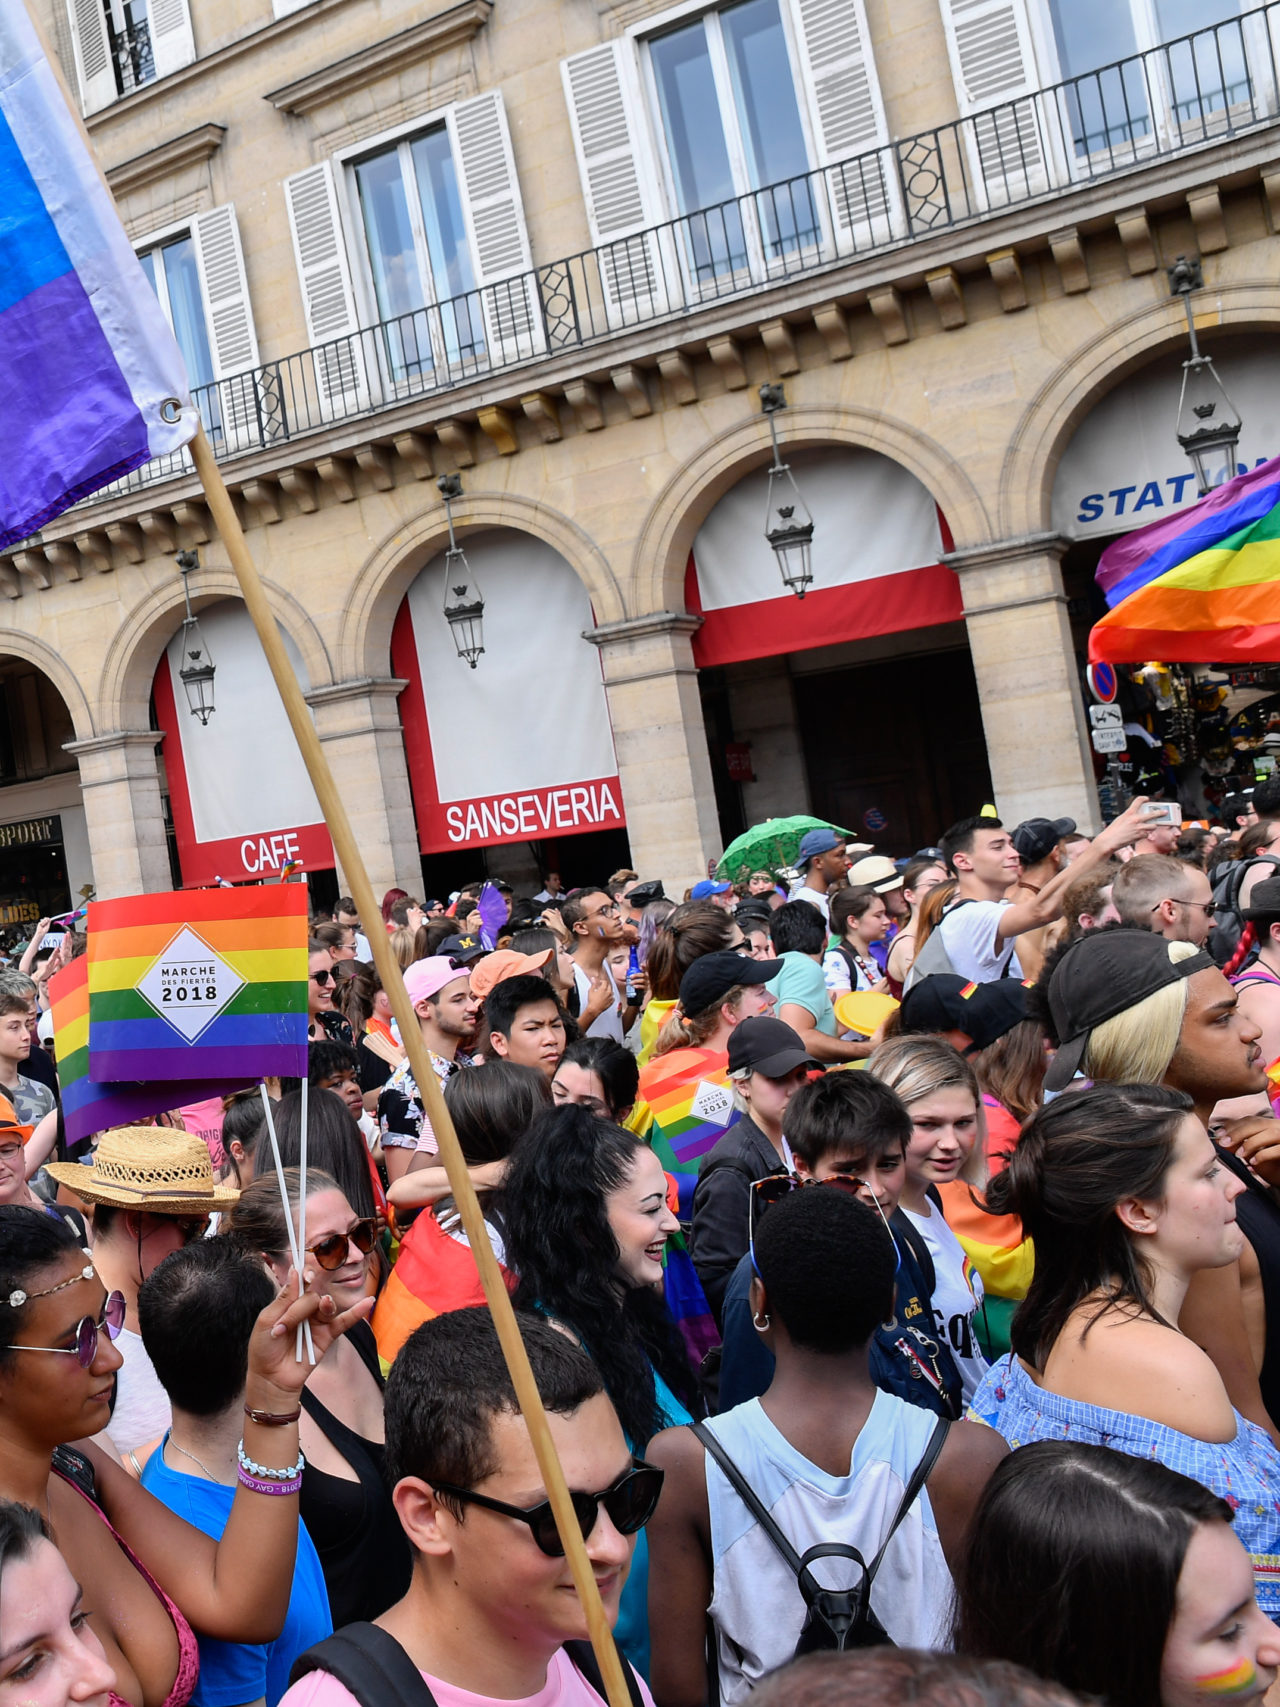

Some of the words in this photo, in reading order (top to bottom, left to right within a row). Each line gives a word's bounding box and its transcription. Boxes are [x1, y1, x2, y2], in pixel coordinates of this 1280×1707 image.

[446, 784, 620, 842] SANSEVERIA
[240, 832, 304, 873] CAFE
[161, 966, 216, 977] MARCHE
[181, 977, 216, 985] FIERTÉS
[162, 985, 217, 1002] 2018
[703, 1099, 728, 1115] 2018
[255, 1483, 274, 1493] GAY
